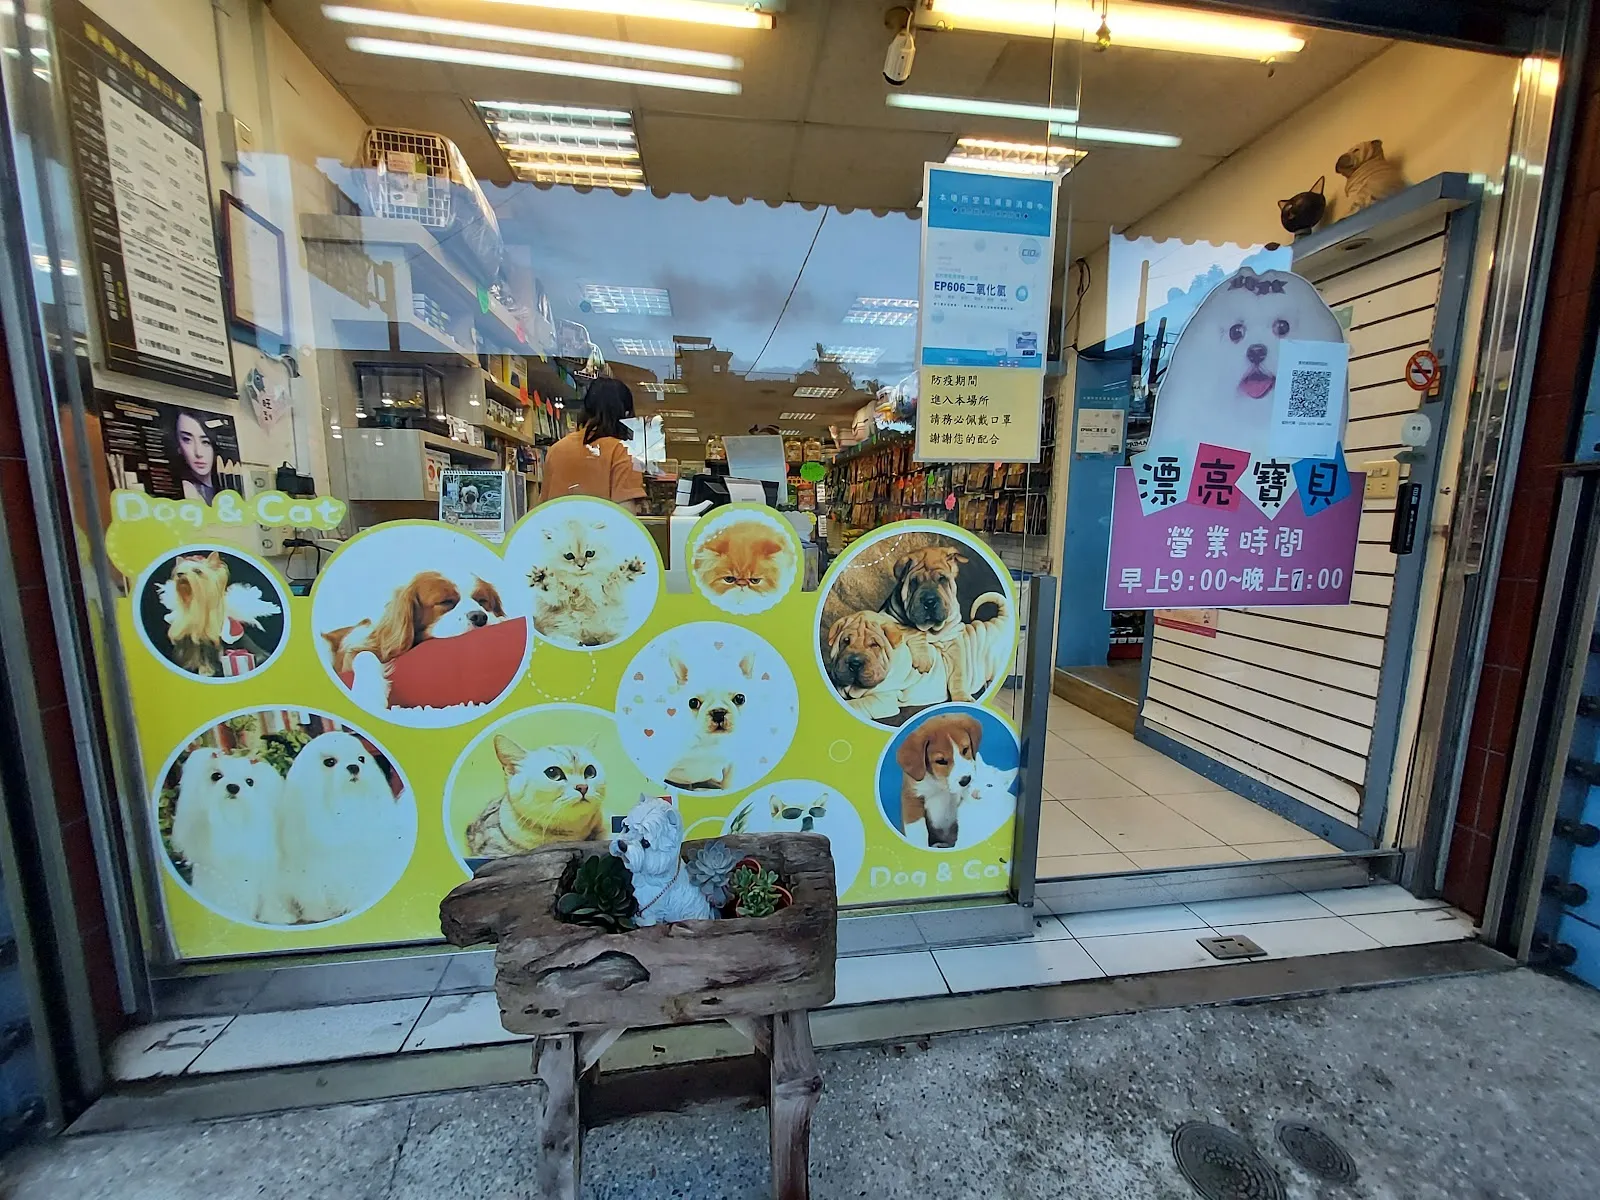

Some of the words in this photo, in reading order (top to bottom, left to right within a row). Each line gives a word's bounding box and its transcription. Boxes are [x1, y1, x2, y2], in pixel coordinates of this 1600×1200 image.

[934, 281, 1007, 297] EP606二氧化氯
[931, 374, 978, 387] 防疫期間
[930, 394, 990, 407] 進入本場所
[930, 414, 1012, 427] 請務必佩戴口罩
[929, 432, 1000, 445] 謝謝您的配合
[1138, 456, 1338, 508] 漂亮寶貝
[116, 492, 204, 528] Dog
[217, 494, 243, 523] &
[257, 495, 342, 527] Cat
[1166, 524, 1304, 559] 營業時間
[870, 865, 927, 888] Dog
[936, 861, 953, 883] &
[963, 859, 1010, 880] Ca
